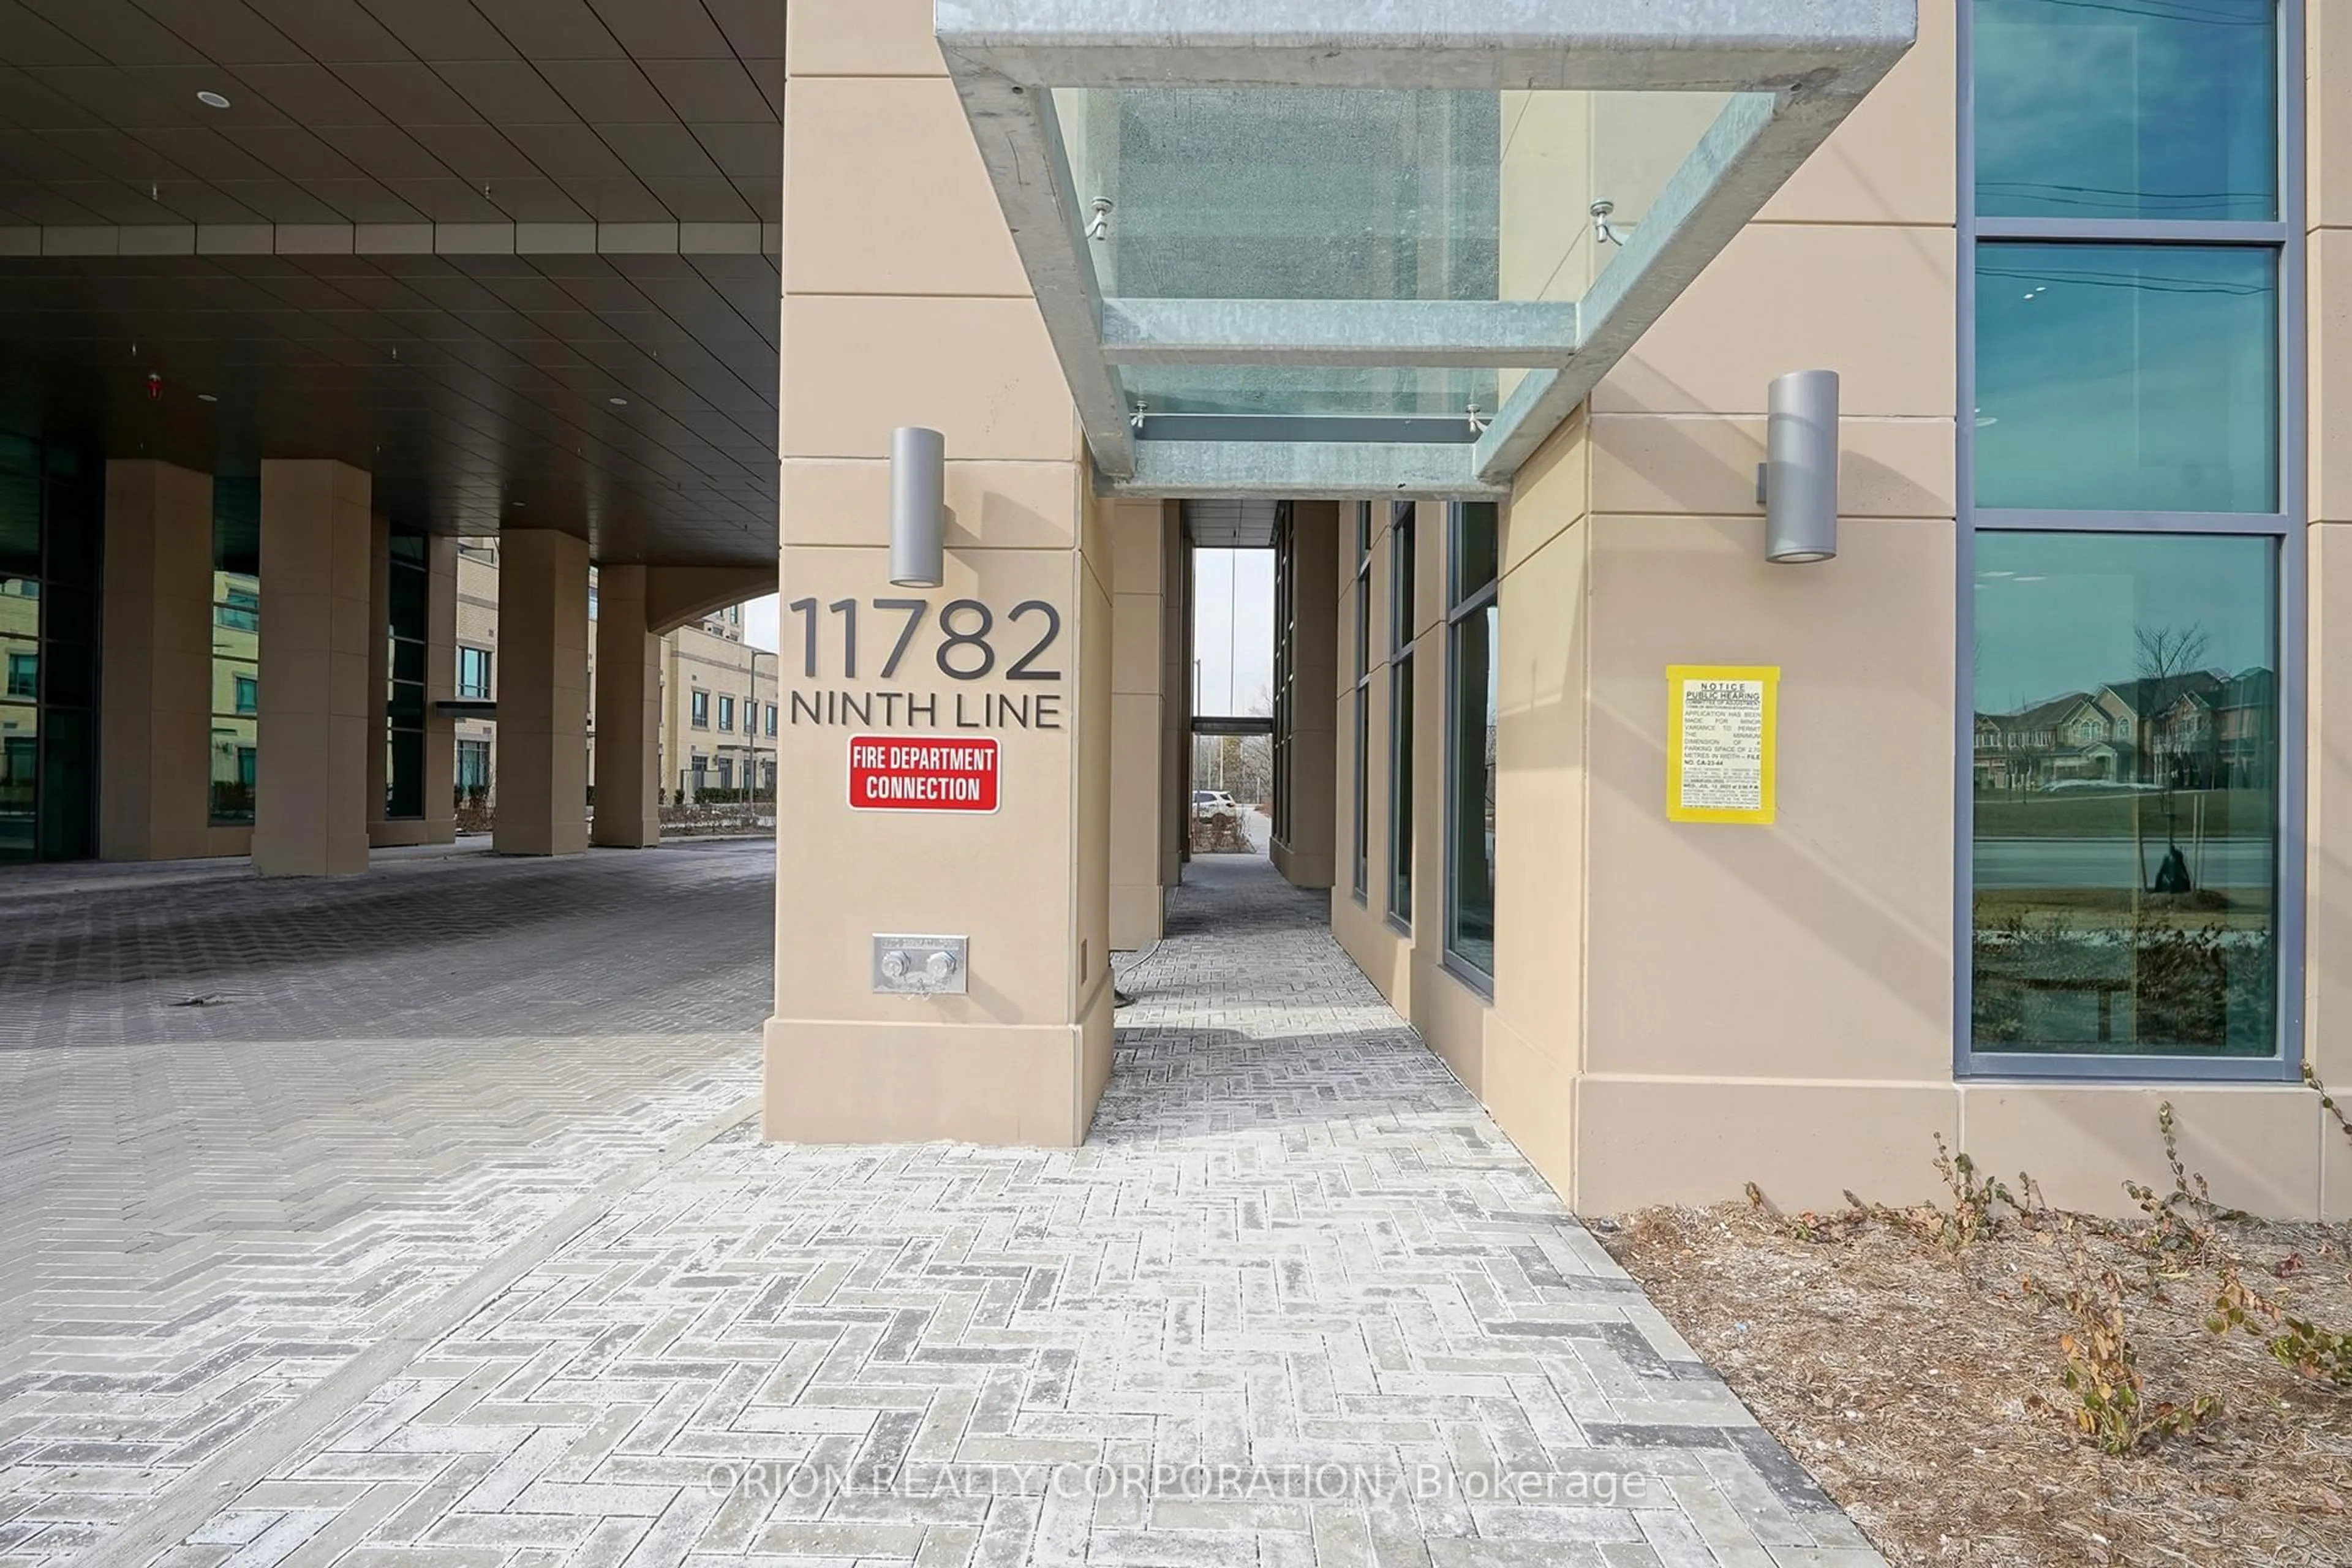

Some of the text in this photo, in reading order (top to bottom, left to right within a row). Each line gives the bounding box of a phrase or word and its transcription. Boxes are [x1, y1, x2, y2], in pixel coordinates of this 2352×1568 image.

[790, 598, 1061, 680] 11782
[1686, 691, 1760, 700] PUBLIC HEARING
[791, 691, 1061, 728] NINTH LINE
[853, 746, 995, 771] FIRE DEPARTMENT
[866, 775, 980, 801] CONNECTION
